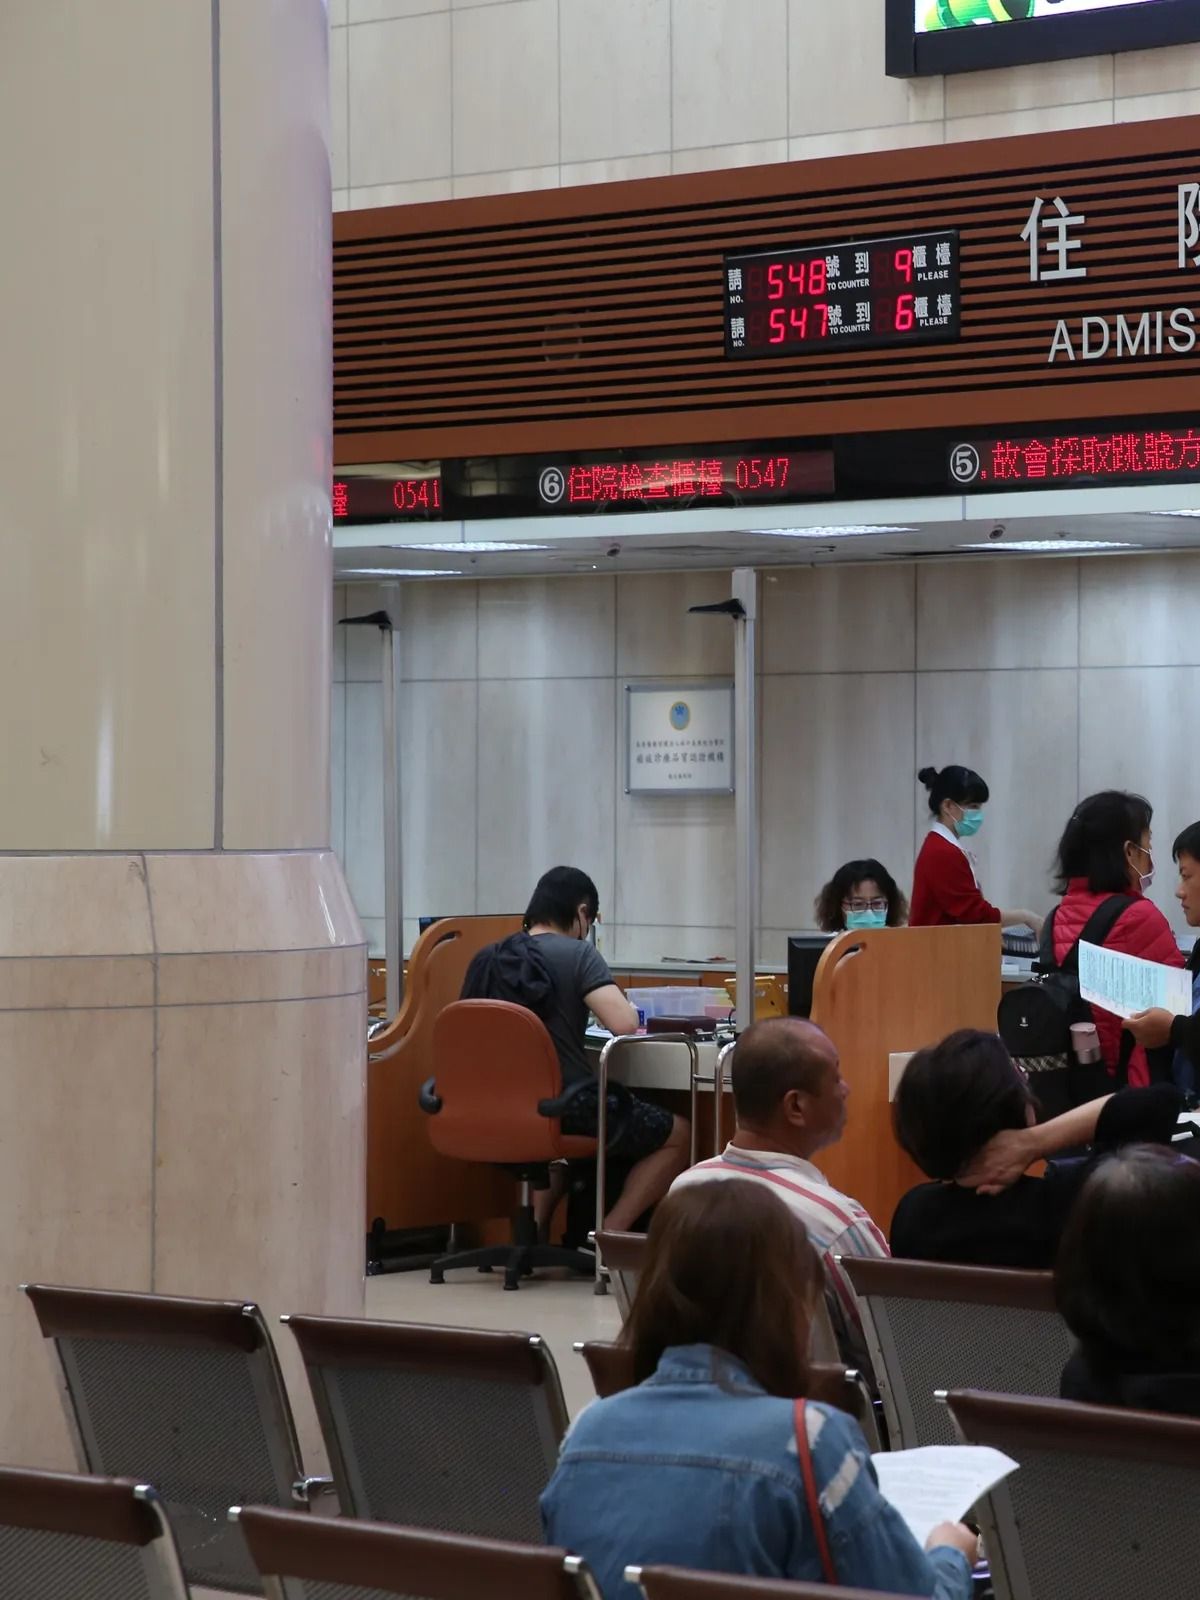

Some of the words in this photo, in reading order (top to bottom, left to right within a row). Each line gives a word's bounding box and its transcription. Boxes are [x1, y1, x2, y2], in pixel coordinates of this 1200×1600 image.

[729, 295, 744, 304] NO.
[827, 282, 837, 291] TO
[838, 278, 870, 290] COUNTER
[917, 270, 949, 281] PLEASE
[768, 260, 826, 299] 548
[894, 249, 912, 283] 9
[733, 339, 745, 347] NO.
[829, 326, 839, 335] TO
[840, 323, 870, 334] COUNTER
[919, 317, 949, 327] PLEASE
[769, 304, 827, 343] 547
[895, 294, 913, 330] 6
[736, 458, 789, 489] 0547
[394, 480, 440, 509] 0541
